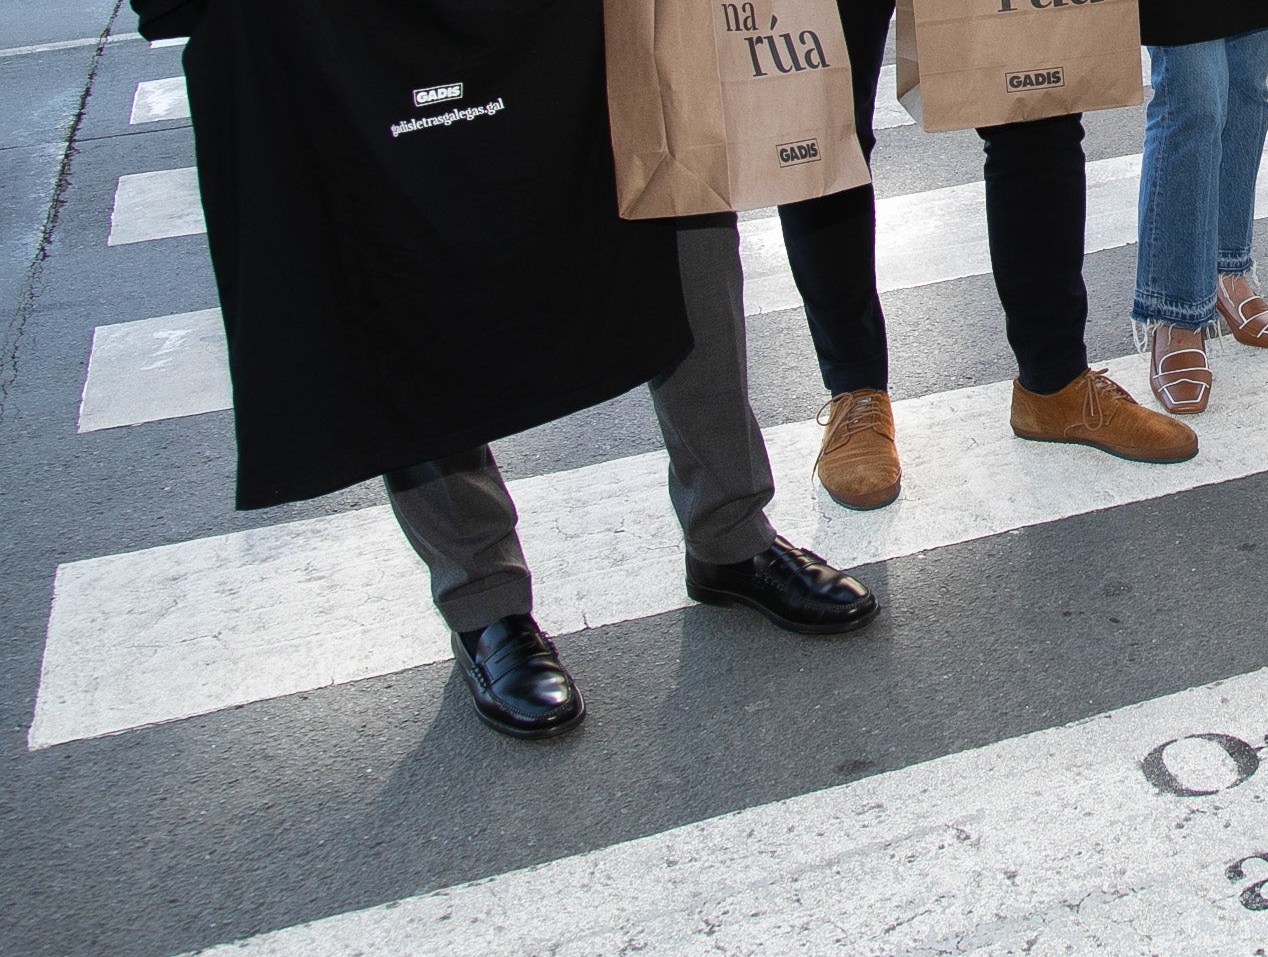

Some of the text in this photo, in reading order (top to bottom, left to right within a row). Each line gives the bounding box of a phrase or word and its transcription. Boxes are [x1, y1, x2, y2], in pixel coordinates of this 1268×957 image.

[721, 3, 760, 33] na
[743, 14, 831, 78] rúa
[1008, 70, 1062, 90] GADIS
[416, 86, 461, 103] GADIS
[390, 97, 505, 137] gadisletrasgalegas.gal
[779, 142, 819, 163] GADIS
